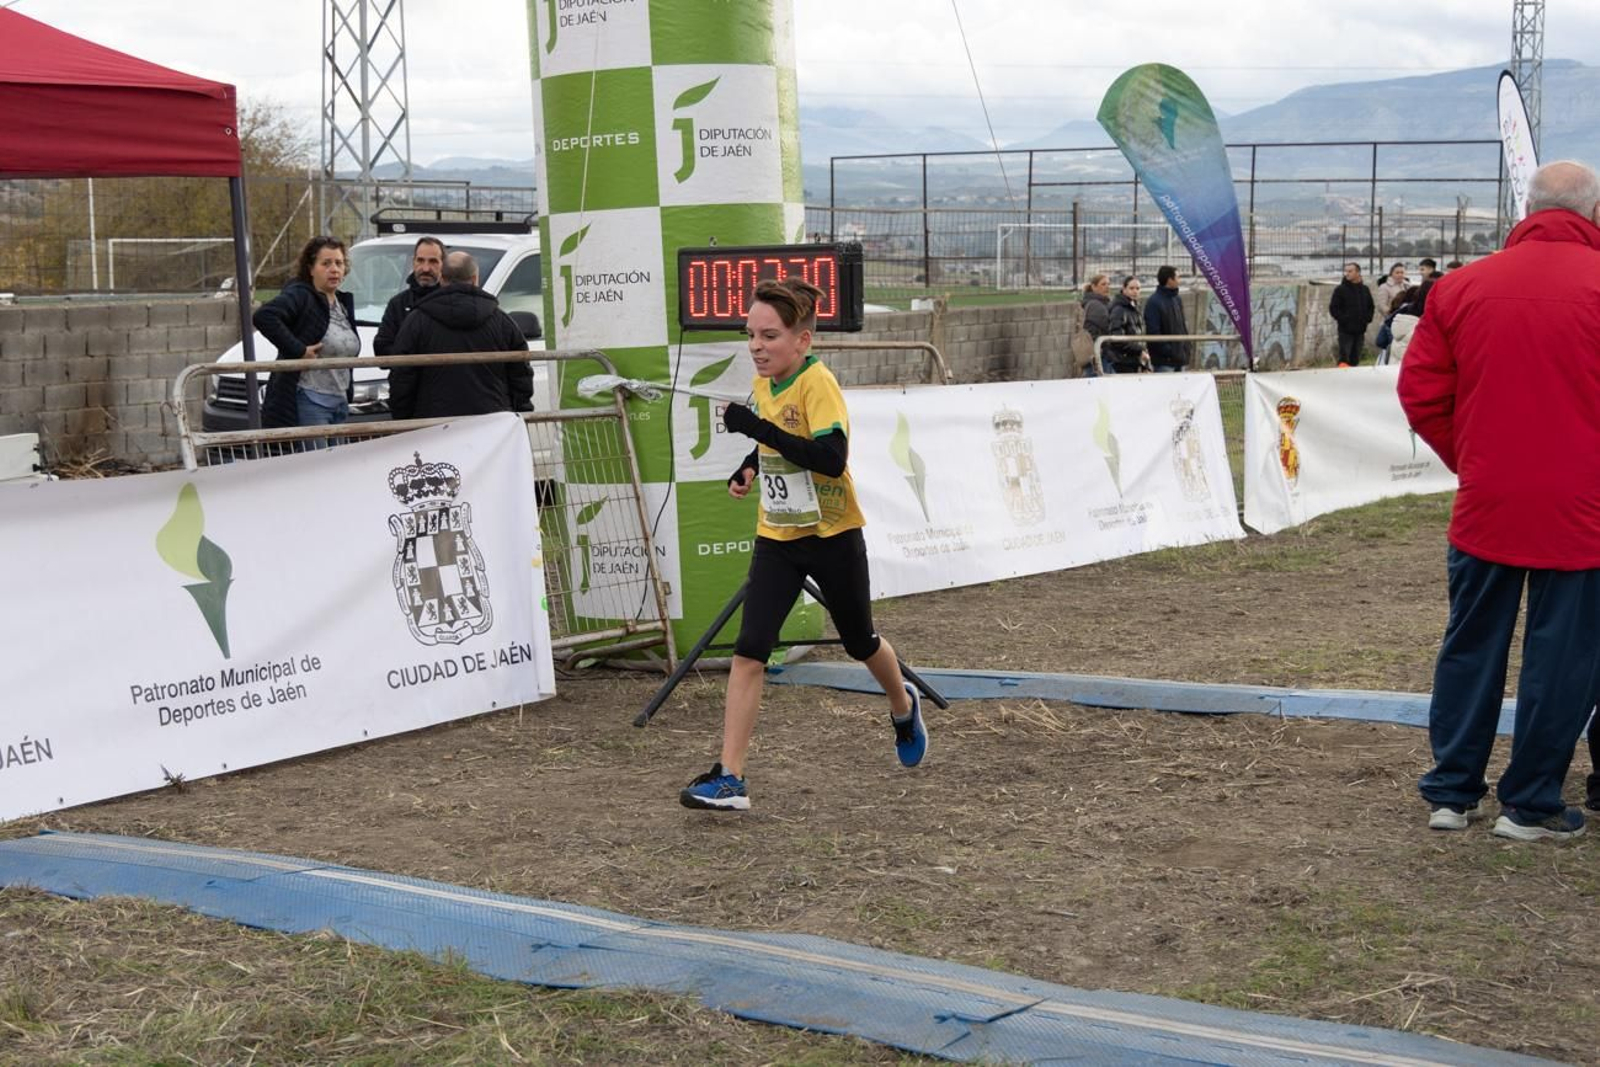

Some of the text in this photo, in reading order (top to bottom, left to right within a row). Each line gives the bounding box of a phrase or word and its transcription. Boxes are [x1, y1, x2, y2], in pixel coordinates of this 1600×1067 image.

[561, 10, 607, 27] DE JAÉN
[552, 132, 639, 151] DEPORTES
[699, 127, 772, 141] DIPUTACIÓN
[700, 144, 752, 157] DE JAÉN
[575, 269, 651, 287] DIPUTACIÓN
[576, 288, 624, 303] DE JAÉN
[764, 474, 788, 499] 39
[698, 540, 755, 556] DEPO
[387, 641, 532, 689] CIUDAD DE JAÉN
[130, 654, 321, 704] Patronato Municipal de
[158, 682, 307, 726] Deportes de Jaén
